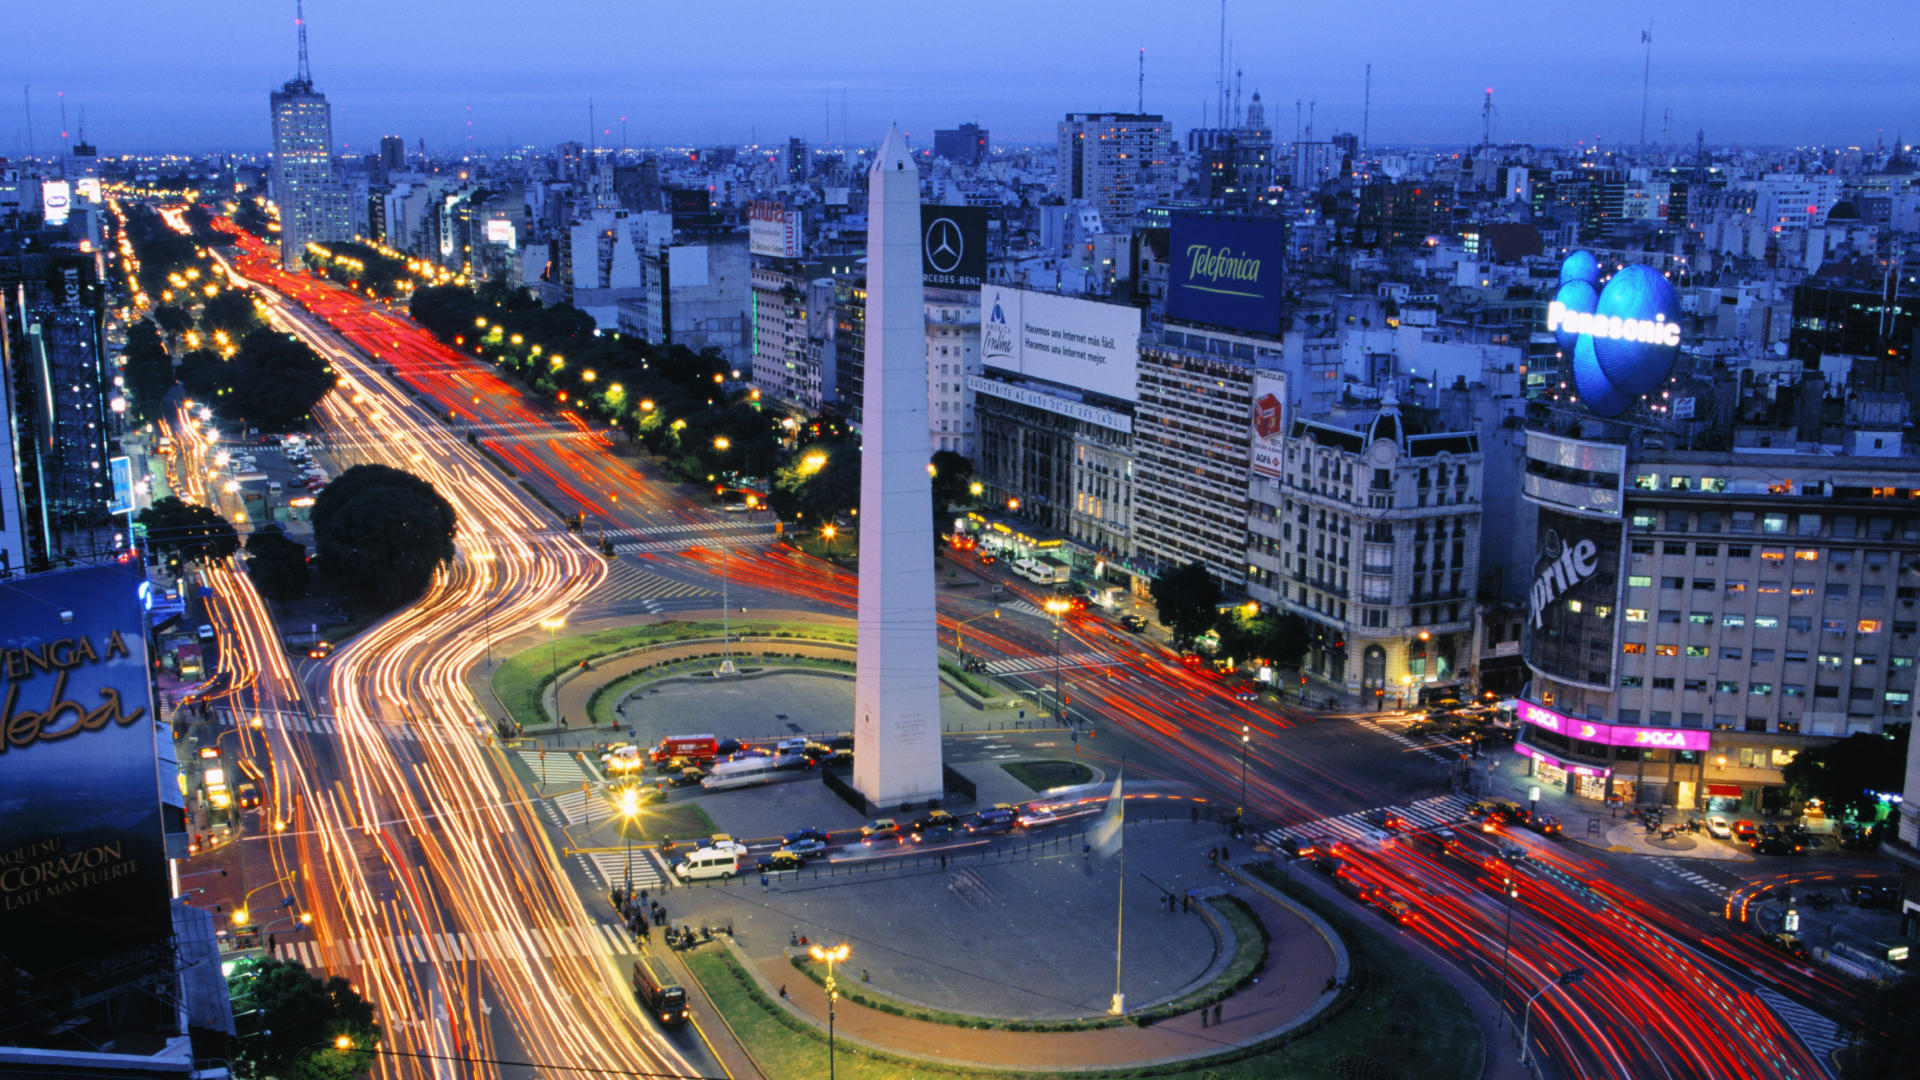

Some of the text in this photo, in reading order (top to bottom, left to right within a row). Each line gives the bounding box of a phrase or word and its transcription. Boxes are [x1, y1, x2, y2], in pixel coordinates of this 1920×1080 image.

[746, 200, 784, 223] aiwa
[785, 212, 793, 257] aiwa
[923, 273, 981, 286] RCEDES-BENZ
[1025, 322, 1050, 336] Hacemos
[1051, 331, 1061, 340] una
[1063, 329, 1086, 344] Internet
[1547, 301, 1681, 346] Panasonic
[1025, 338, 1107, 366] Hacemos una Internet mejor.
[1256, 453, 1271, 465] AGFA
[0, 629, 128, 677] ENGA A
[0, 840, 121, 892] CORAZON
[5, 889, 40, 910] LATE
[82, 860, 138, 887] FUERTE
